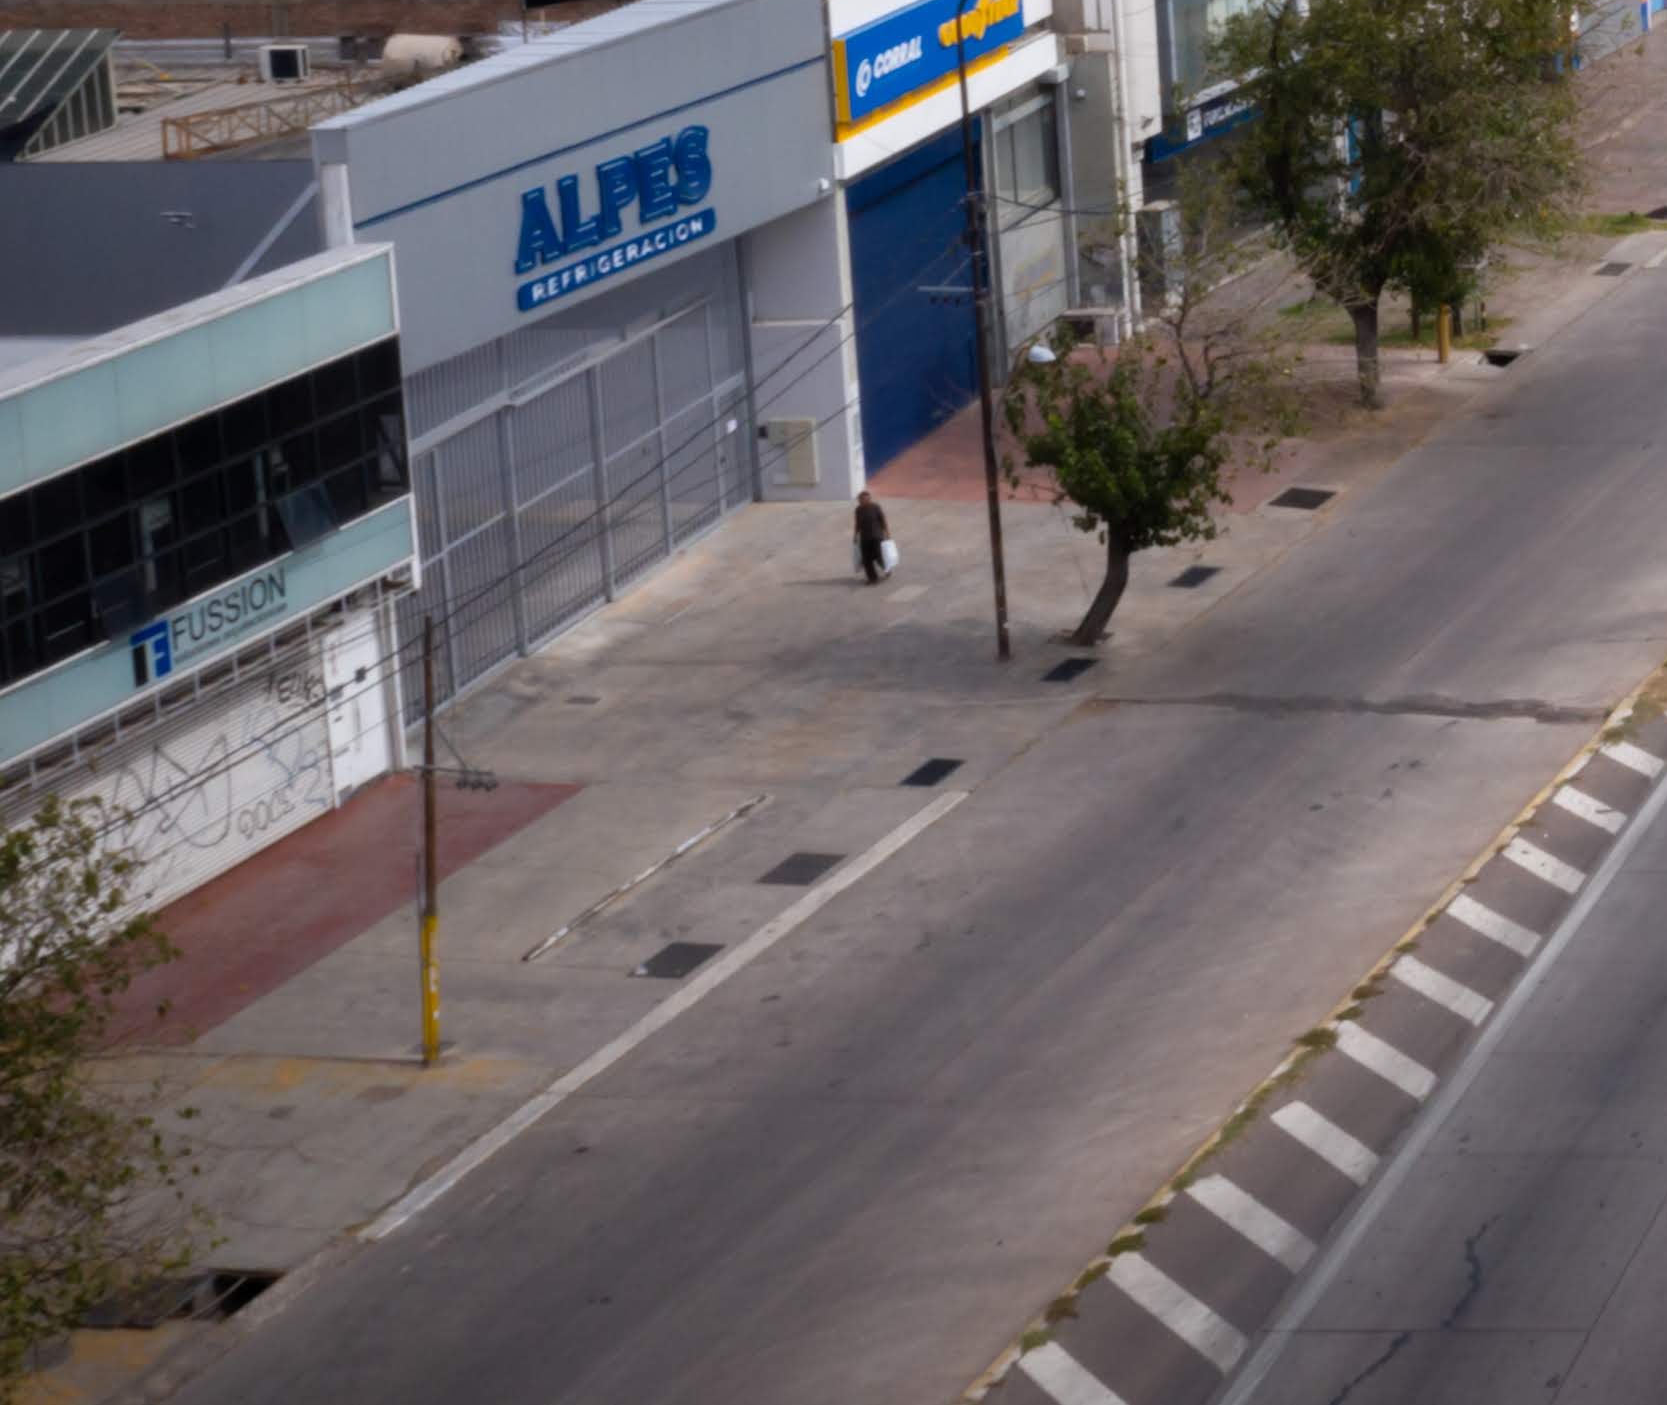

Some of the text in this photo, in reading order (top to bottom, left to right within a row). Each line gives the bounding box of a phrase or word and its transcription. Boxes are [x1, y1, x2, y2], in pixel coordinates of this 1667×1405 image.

[872, 35, 923, 79] CORRAL
[514, 123, 713, 277] ALPES
[531, 217, 704, 303] REFRIGERACION
[171, 566, 287, 650] FUSSION
